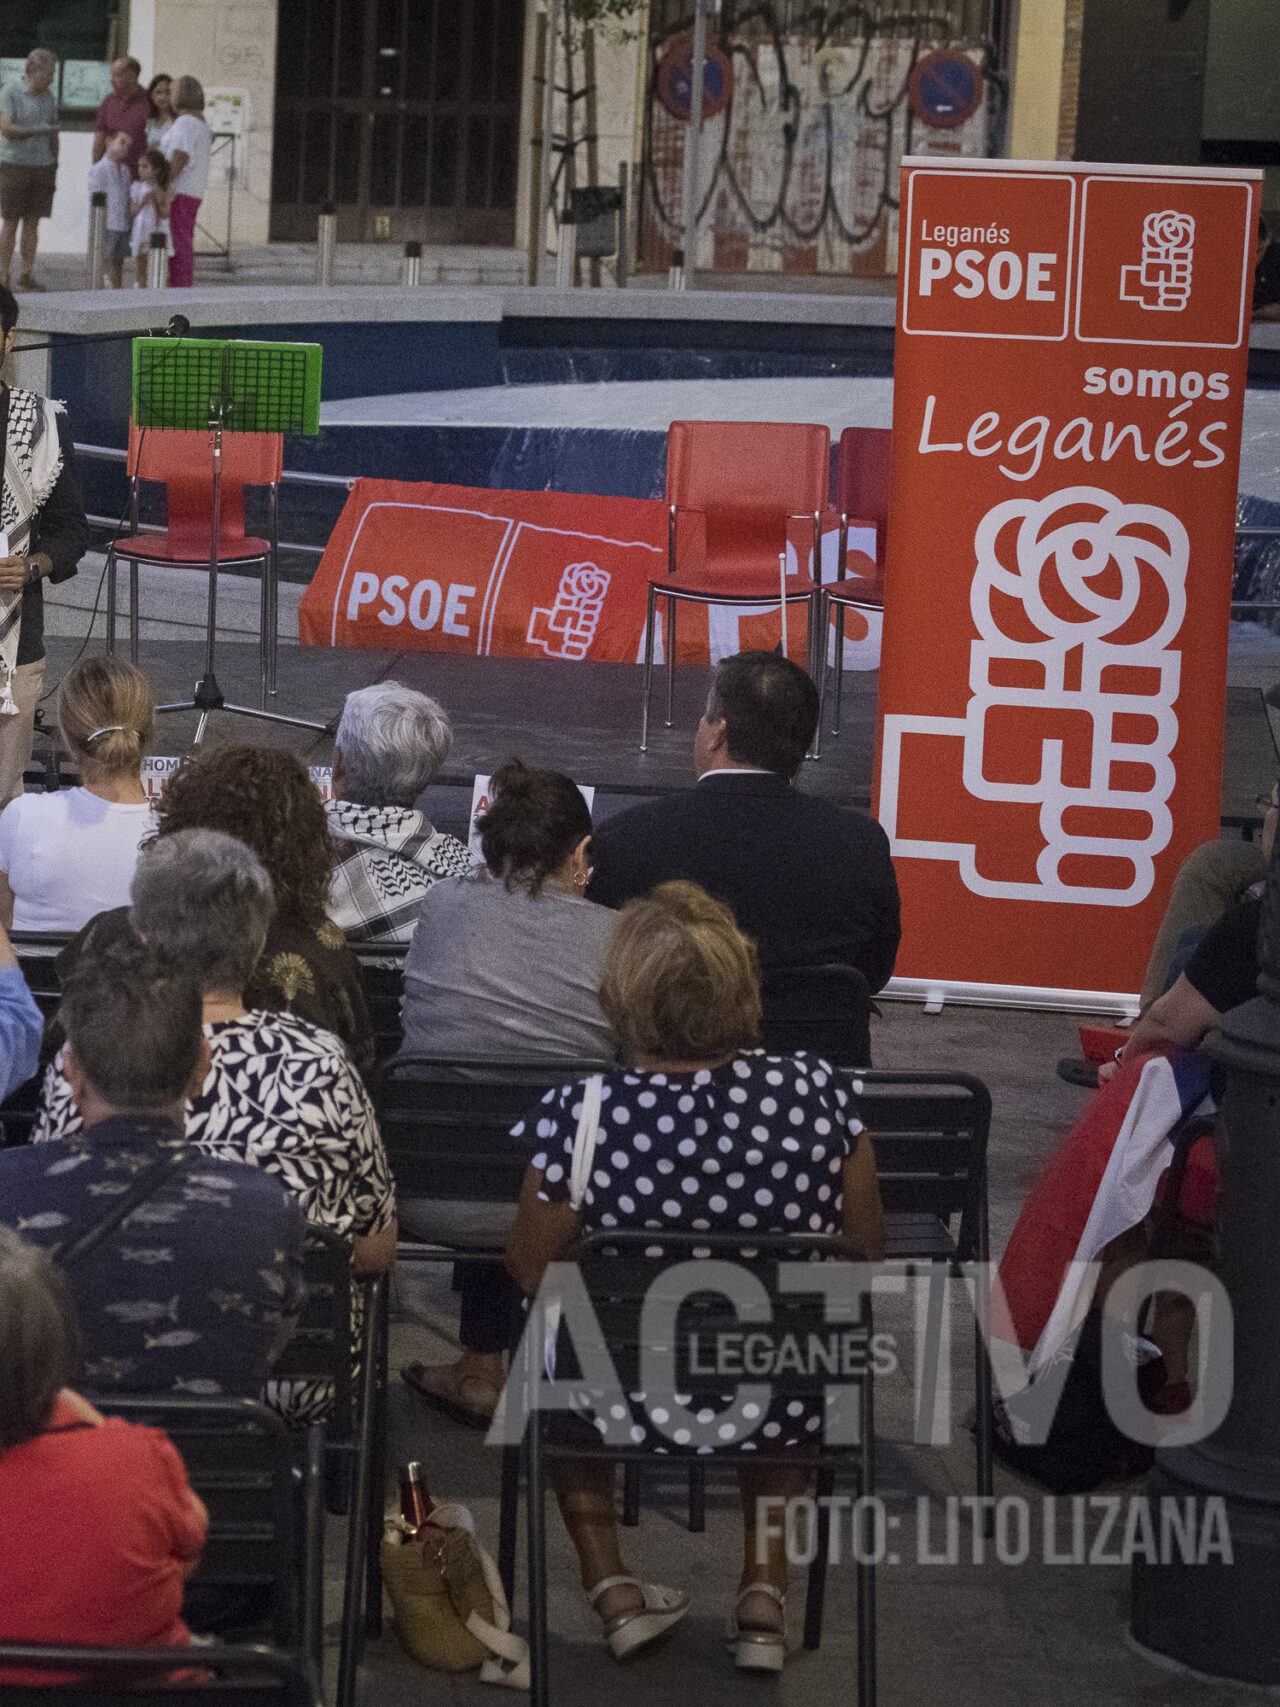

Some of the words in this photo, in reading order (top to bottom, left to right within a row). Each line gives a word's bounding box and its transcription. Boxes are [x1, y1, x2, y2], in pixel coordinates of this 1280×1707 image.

[922, 219, 1010, 247] Leganés
[919, 248, 1057, 301] PSOE
[1083, 366, 1230, 400] somos
[918, 395, 1228, 481] Leganés
[347, 572, 477, 638] PSOE
